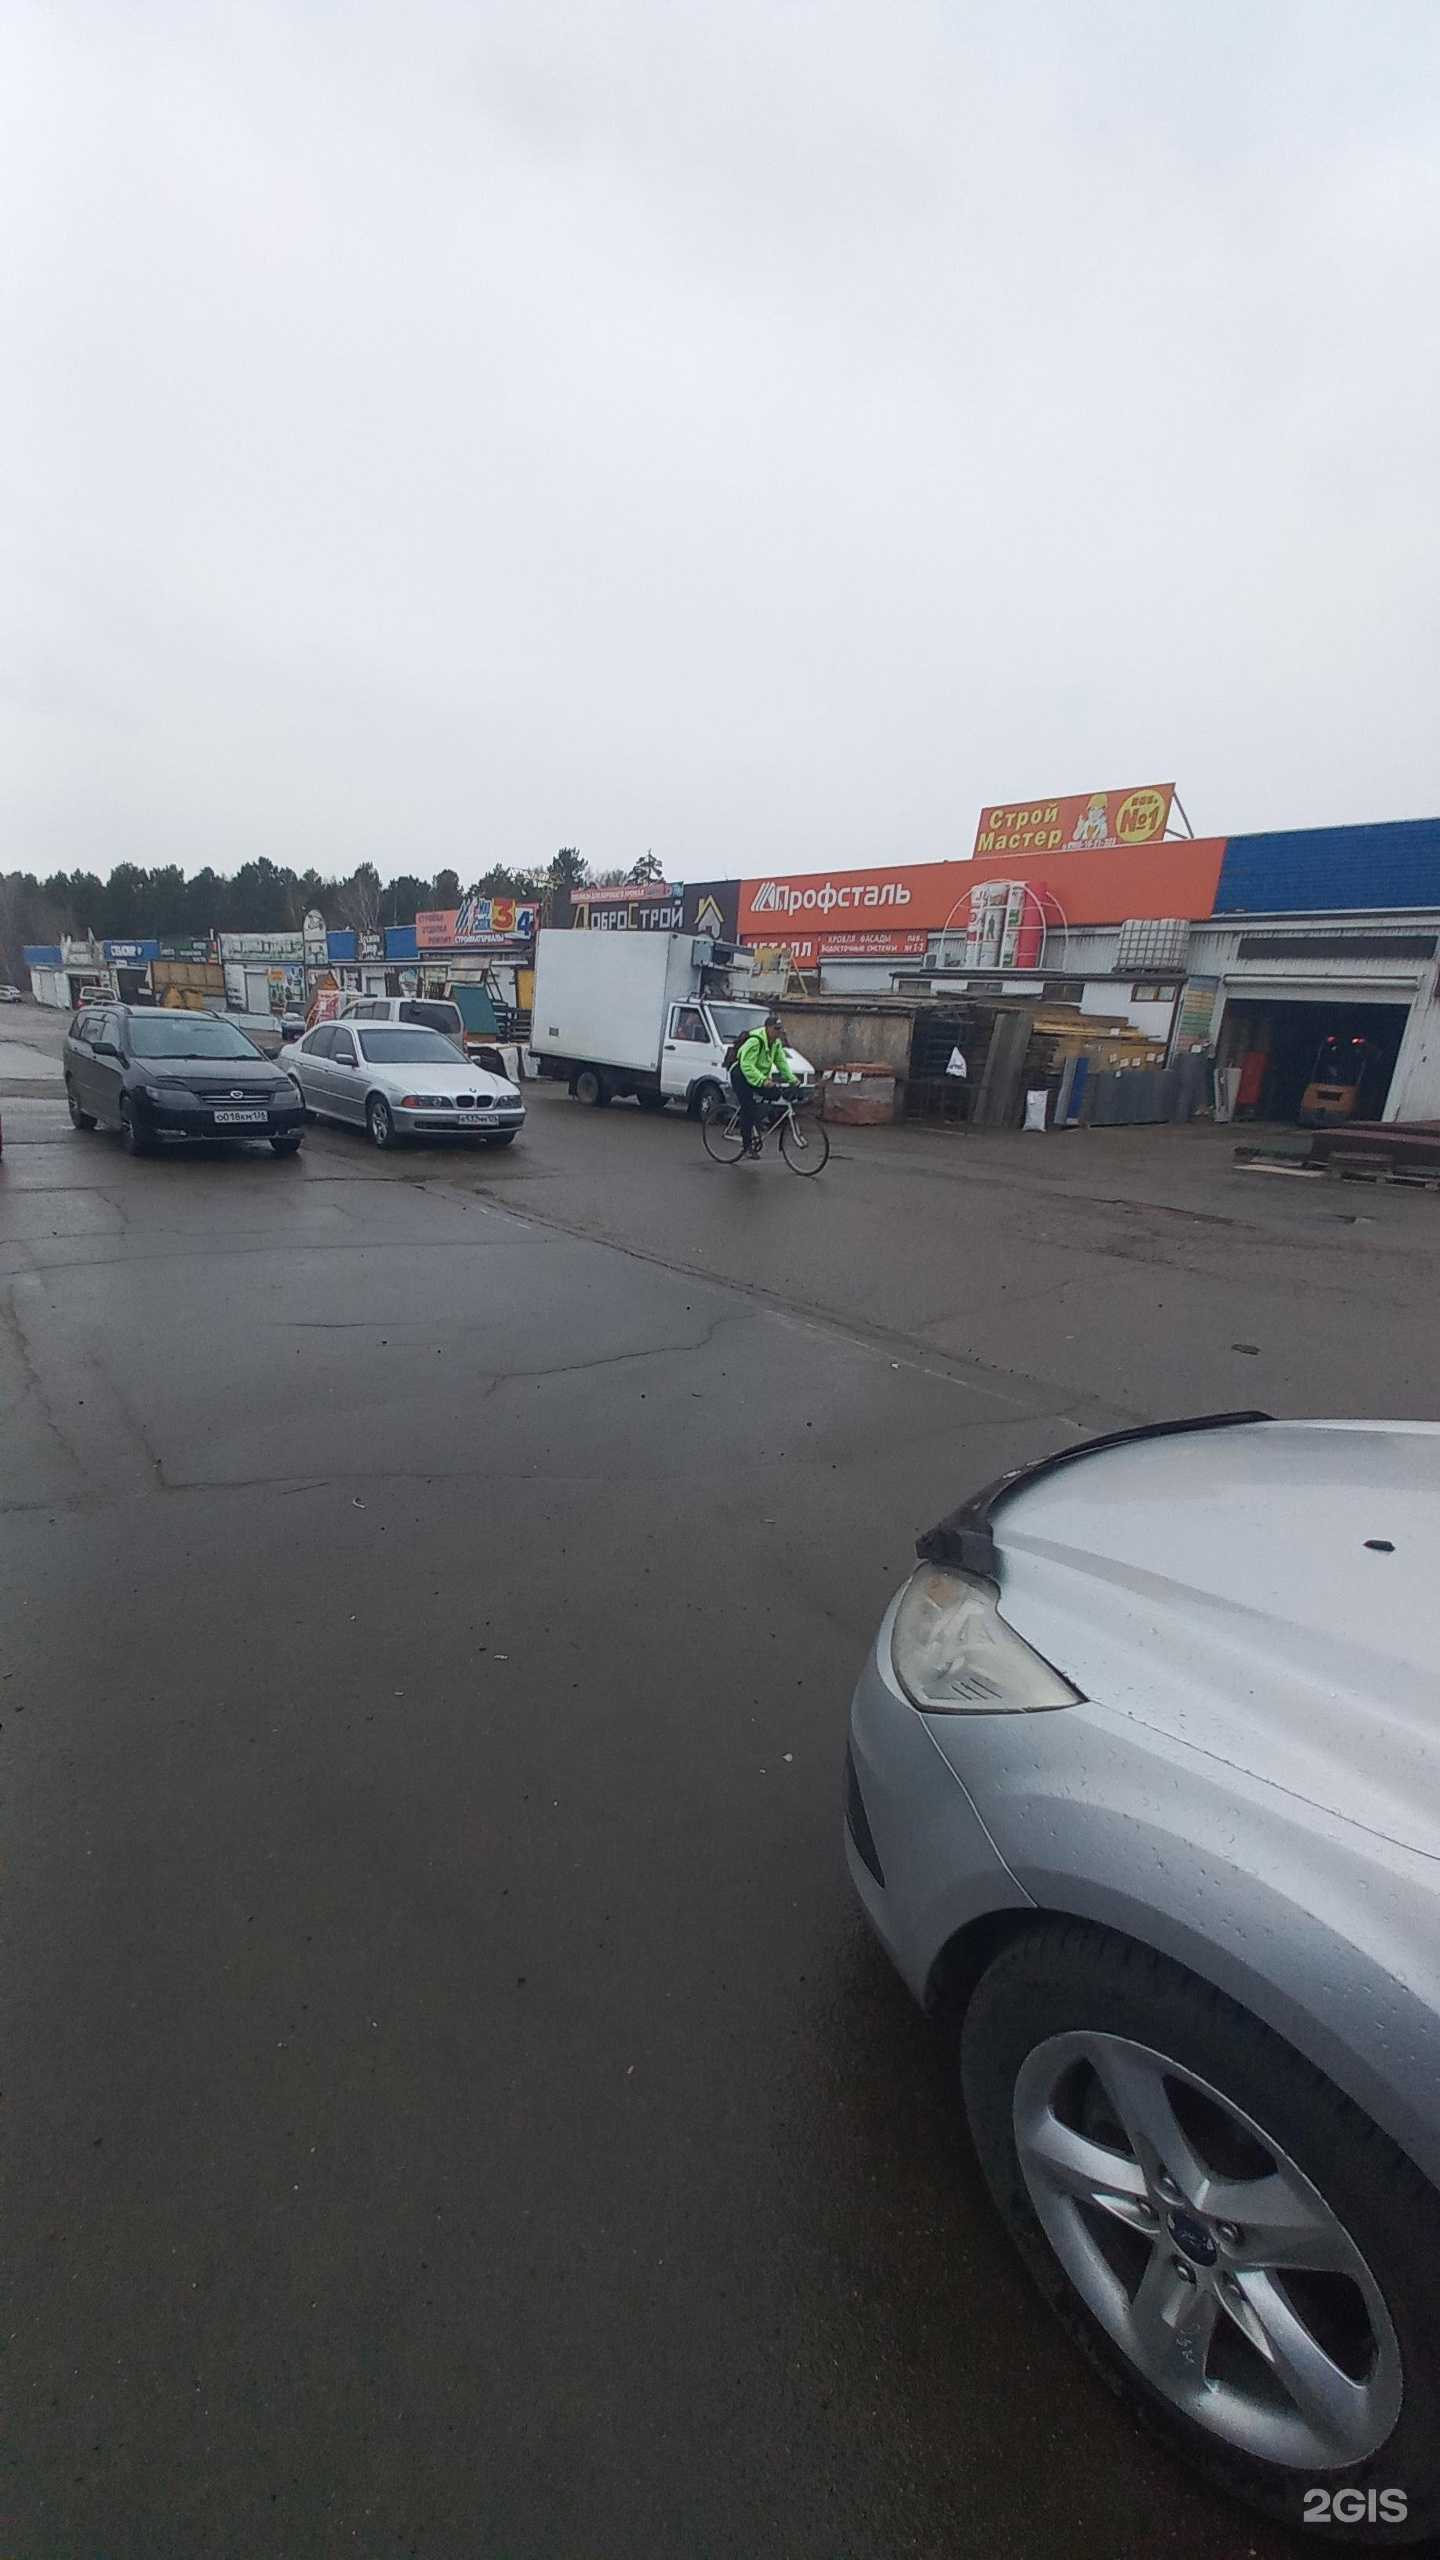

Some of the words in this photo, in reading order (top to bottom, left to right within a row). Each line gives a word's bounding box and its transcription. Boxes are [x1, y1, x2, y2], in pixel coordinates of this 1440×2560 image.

[988, 801, 1058, 830] Строй
[1119, 805, 1160, 833] №1
[977, 829, 1063, 852] Мастер
[775, 882, 912, 916] Профсталь
[494, 899, 514, 930] 3
[828, 934, 856, 944] КРОВЛЯ
[859, 933, 893, 944] ФАСАДЫ
